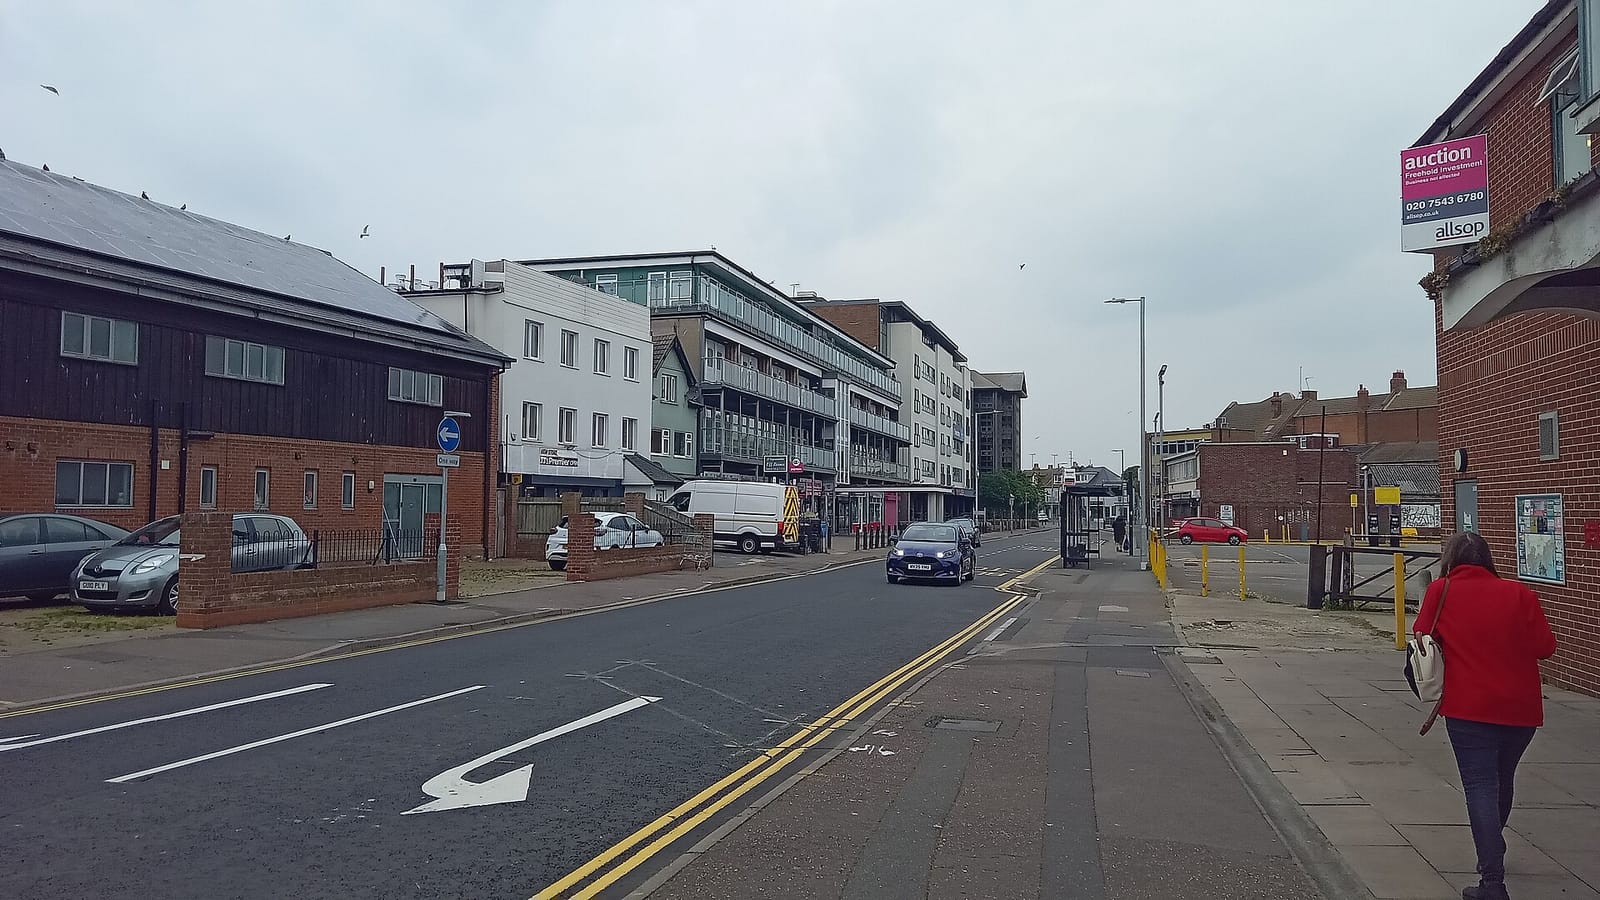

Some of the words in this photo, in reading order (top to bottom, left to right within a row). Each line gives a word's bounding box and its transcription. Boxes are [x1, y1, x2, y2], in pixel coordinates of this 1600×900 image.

[1405, 146, 1471, 170] auction
[1405, 167, 1439, 179] Freehold
[1440, 159, 1483, 173] Investment
[1405, 177, 1429, 186] Business
[1406, 201, 1426, 211] 020
[1428, 196, 1454, 208] 7543
[1456, 191, 1484, 203] 6780
[1406, 210, 1439, 220] allsop.co.uk
[1435, 221, 1485, 238] allsop
